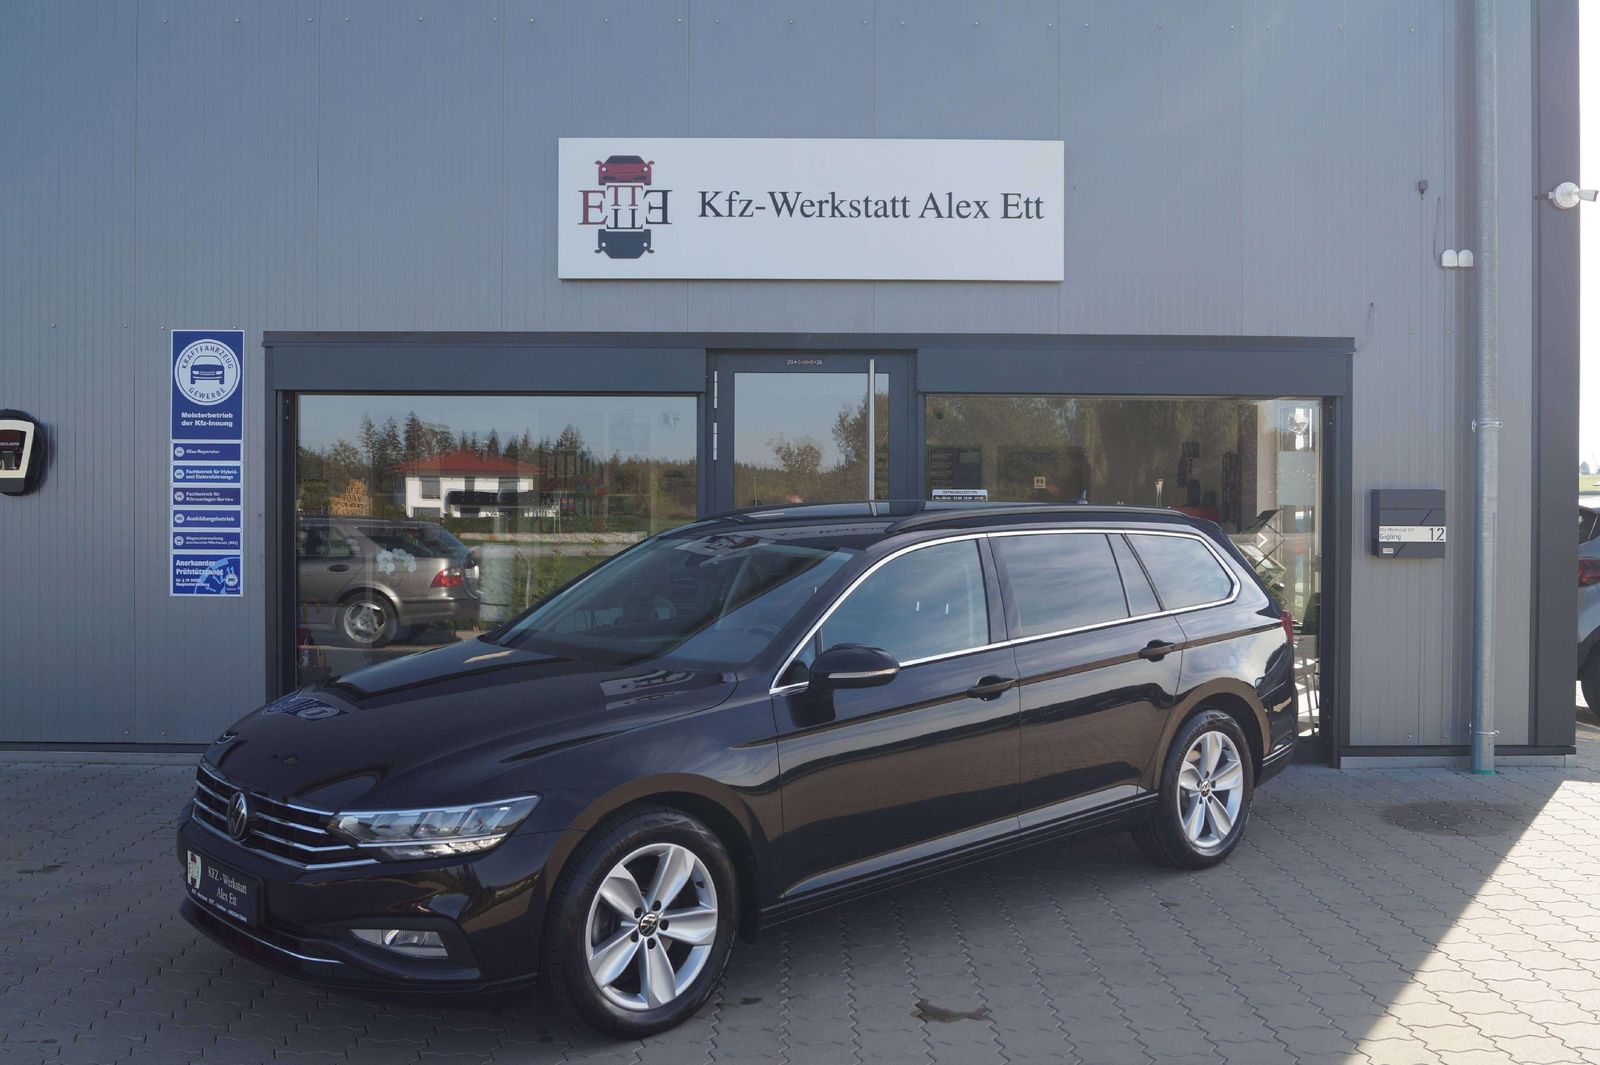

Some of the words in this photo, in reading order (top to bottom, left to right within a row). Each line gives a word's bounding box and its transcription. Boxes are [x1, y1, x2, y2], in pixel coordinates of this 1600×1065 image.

[698, 190, 911, 219] Kfz-Werkstatt
[918, 191, 991, 219] Alex
[1000, 192, 1045, 219] Ett
[181, 345, 234, 369] KRAFTFAHRZEUG
[189, 387, 226, 400] GEWERBE
[195, 420, 233, 428] Kfz-Innung
[1429, 527, 1445, 541] 12
[176, 559, 215, 567] Anerkannter
